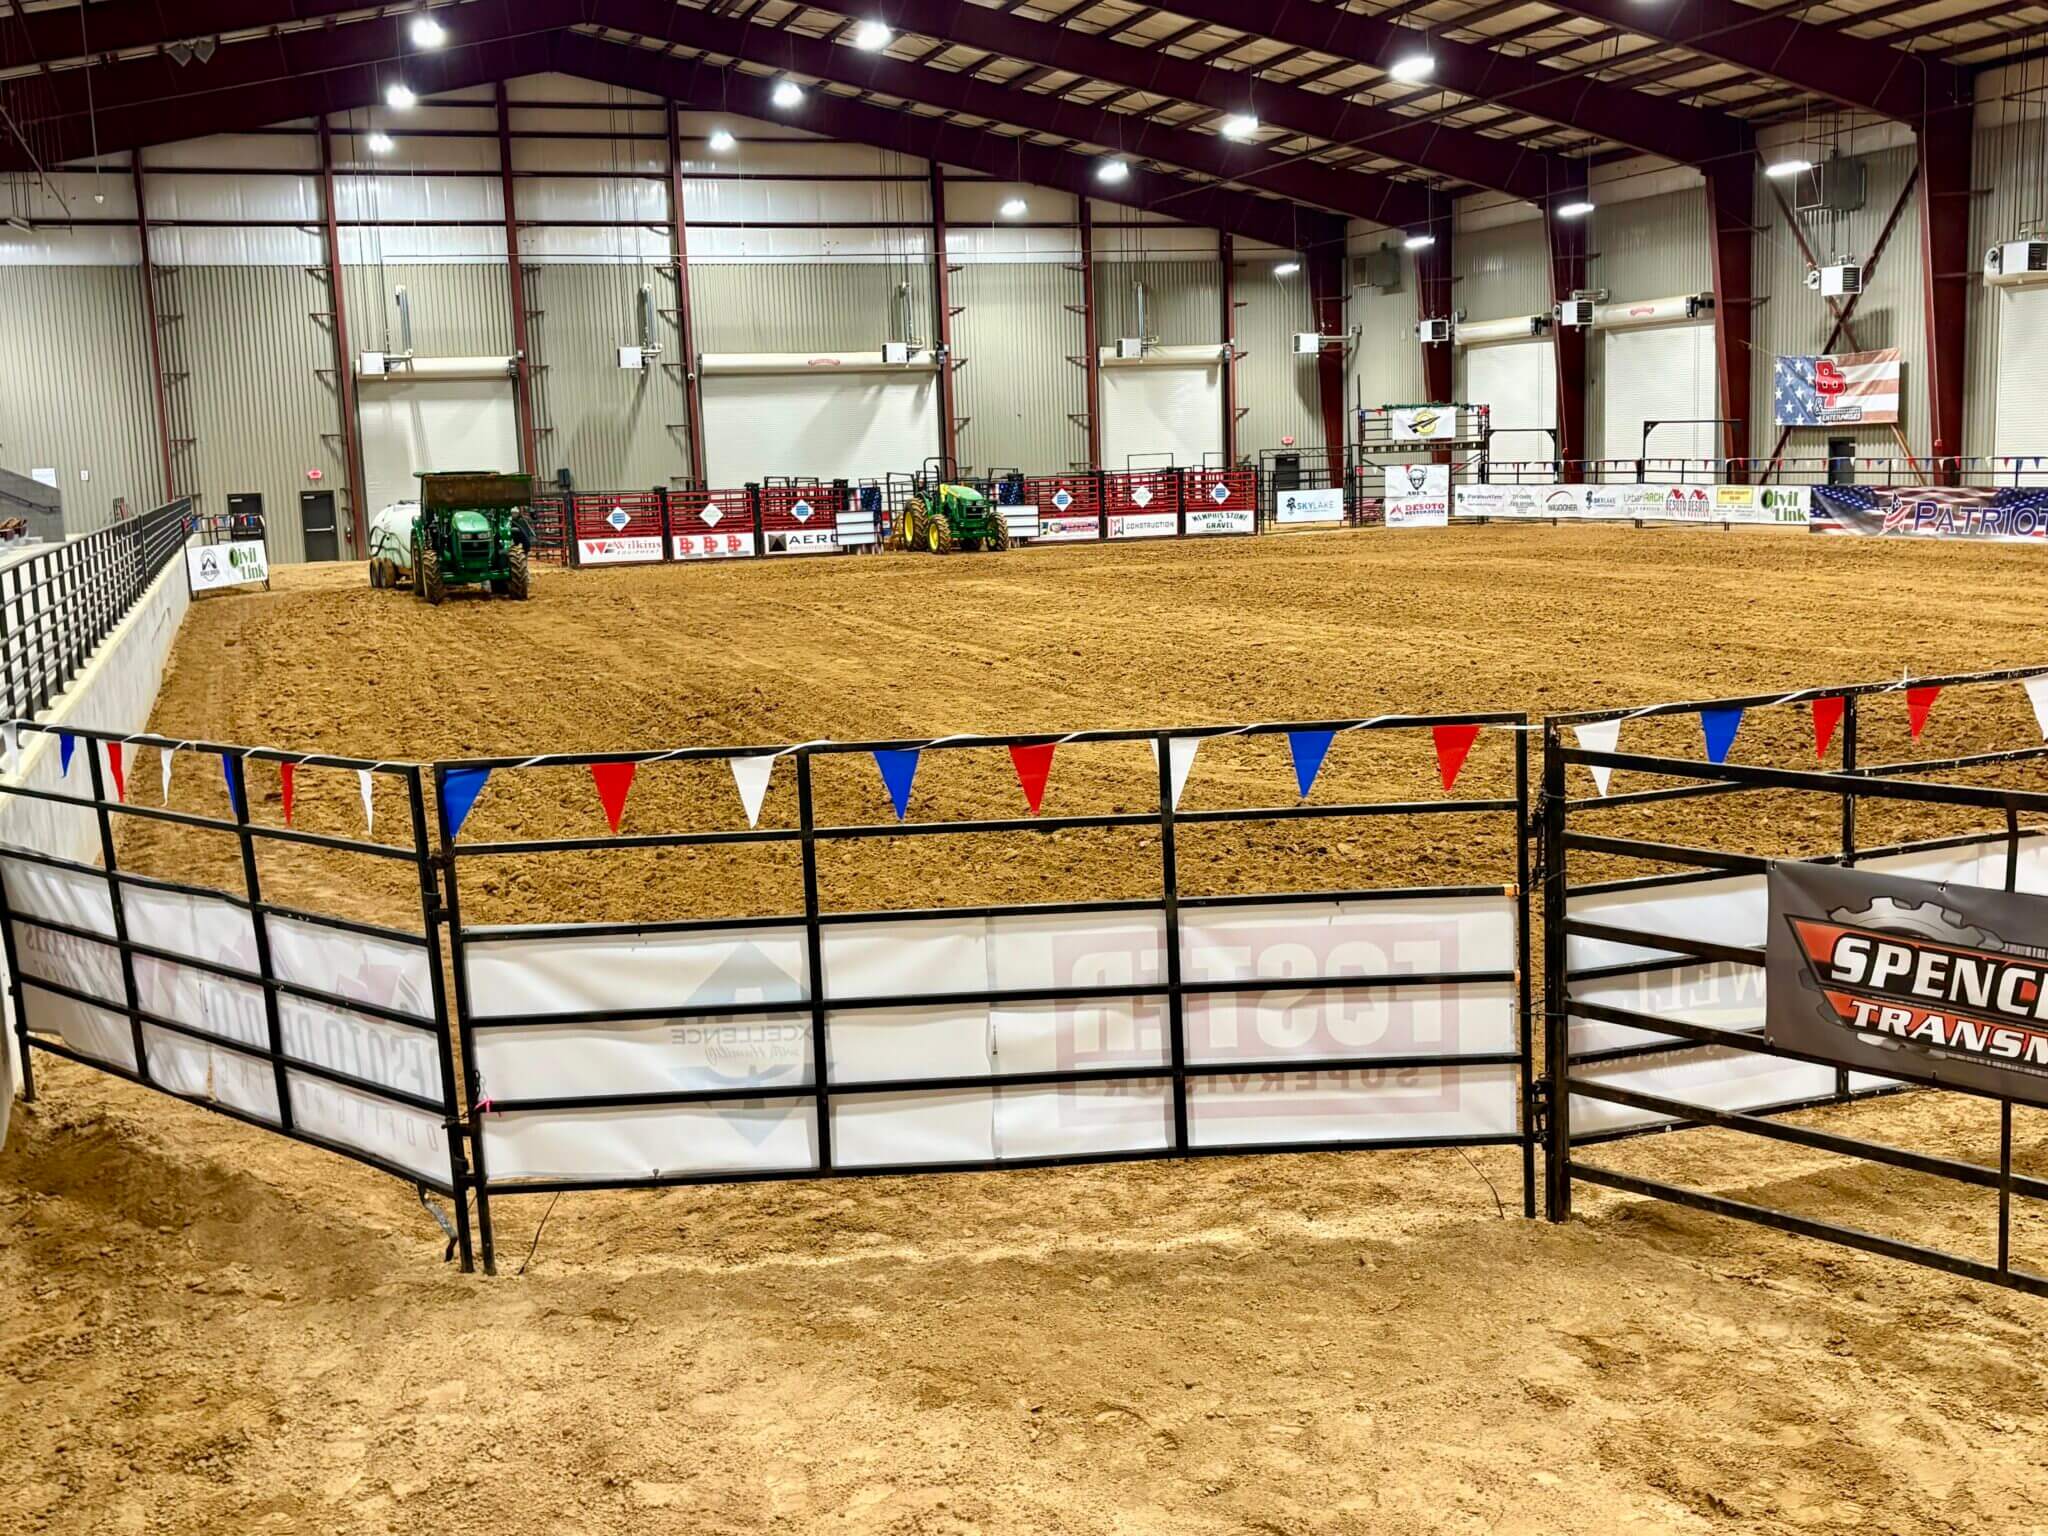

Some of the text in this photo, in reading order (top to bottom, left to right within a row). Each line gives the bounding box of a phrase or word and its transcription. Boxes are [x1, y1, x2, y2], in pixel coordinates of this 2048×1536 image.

[1761, 489, 1799, 509] Civil
[1405, 503, 1445, 511] DESOTO
[1191, 512, 1248, 521] MEMPHIS STONE
[1775, 508, 1807, 521] Link
[1126, 521, 1175, 530] CONSTRUCTION
[229, 547, 257, 568] Civil
[241, 564, 266, 580] Link
